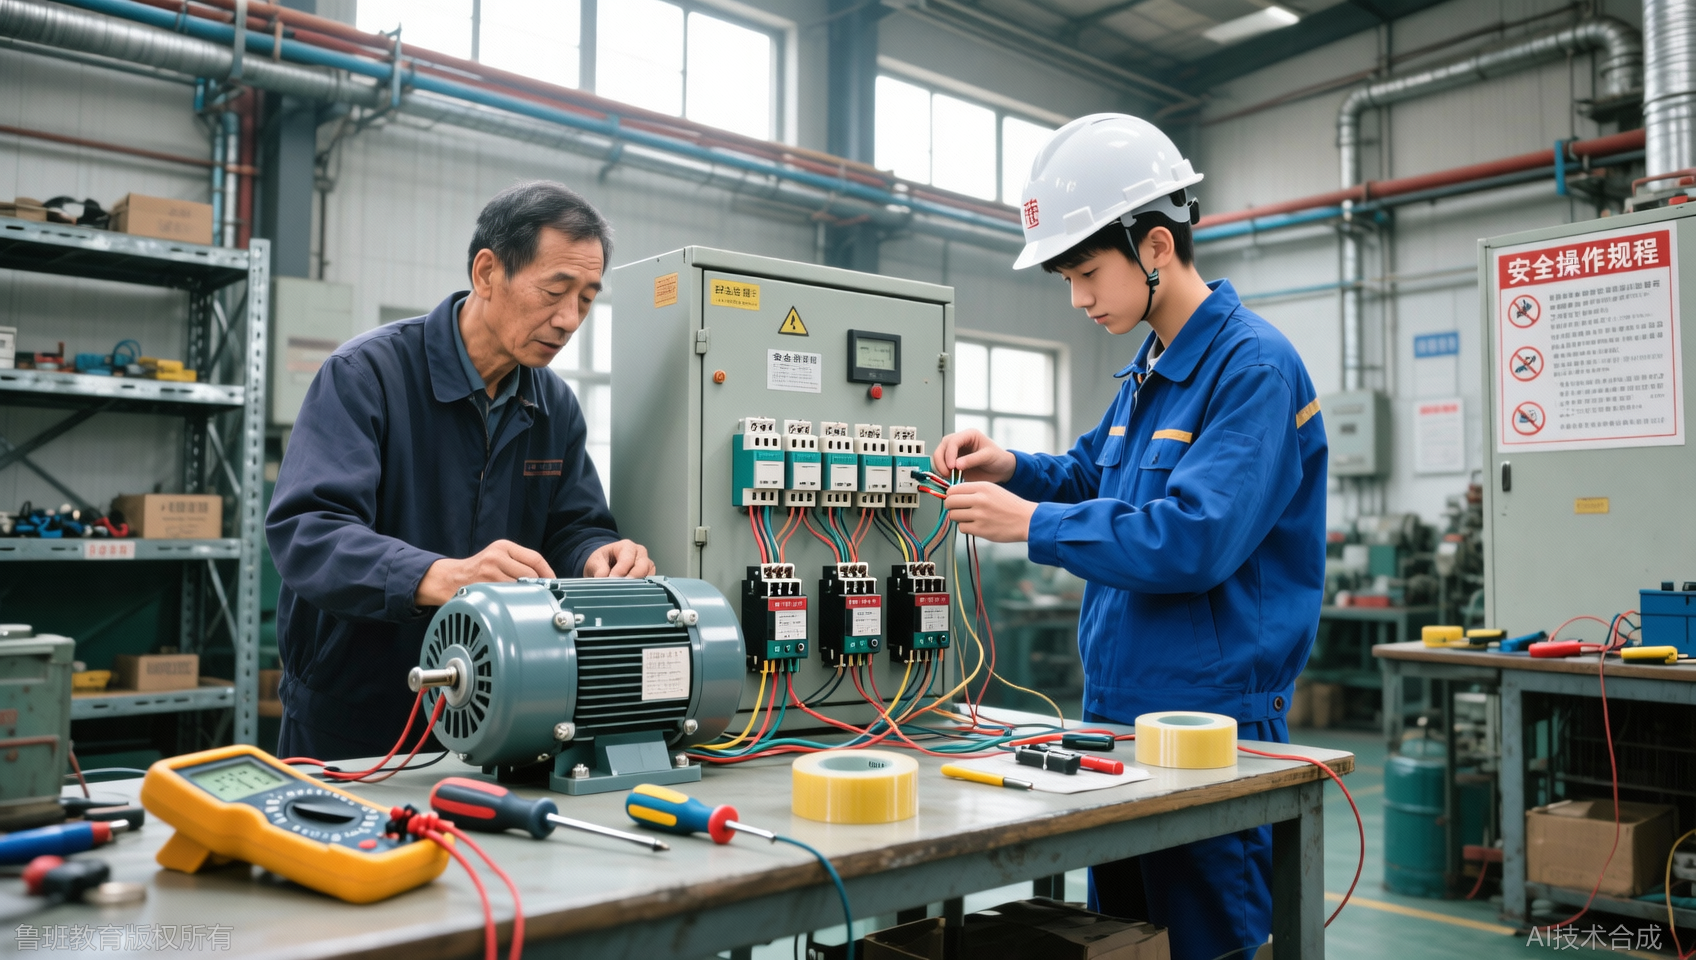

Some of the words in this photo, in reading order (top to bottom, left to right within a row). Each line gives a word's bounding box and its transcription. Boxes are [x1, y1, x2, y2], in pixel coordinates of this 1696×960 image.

[1507, 237, 1660, 285] 安全操作规程
